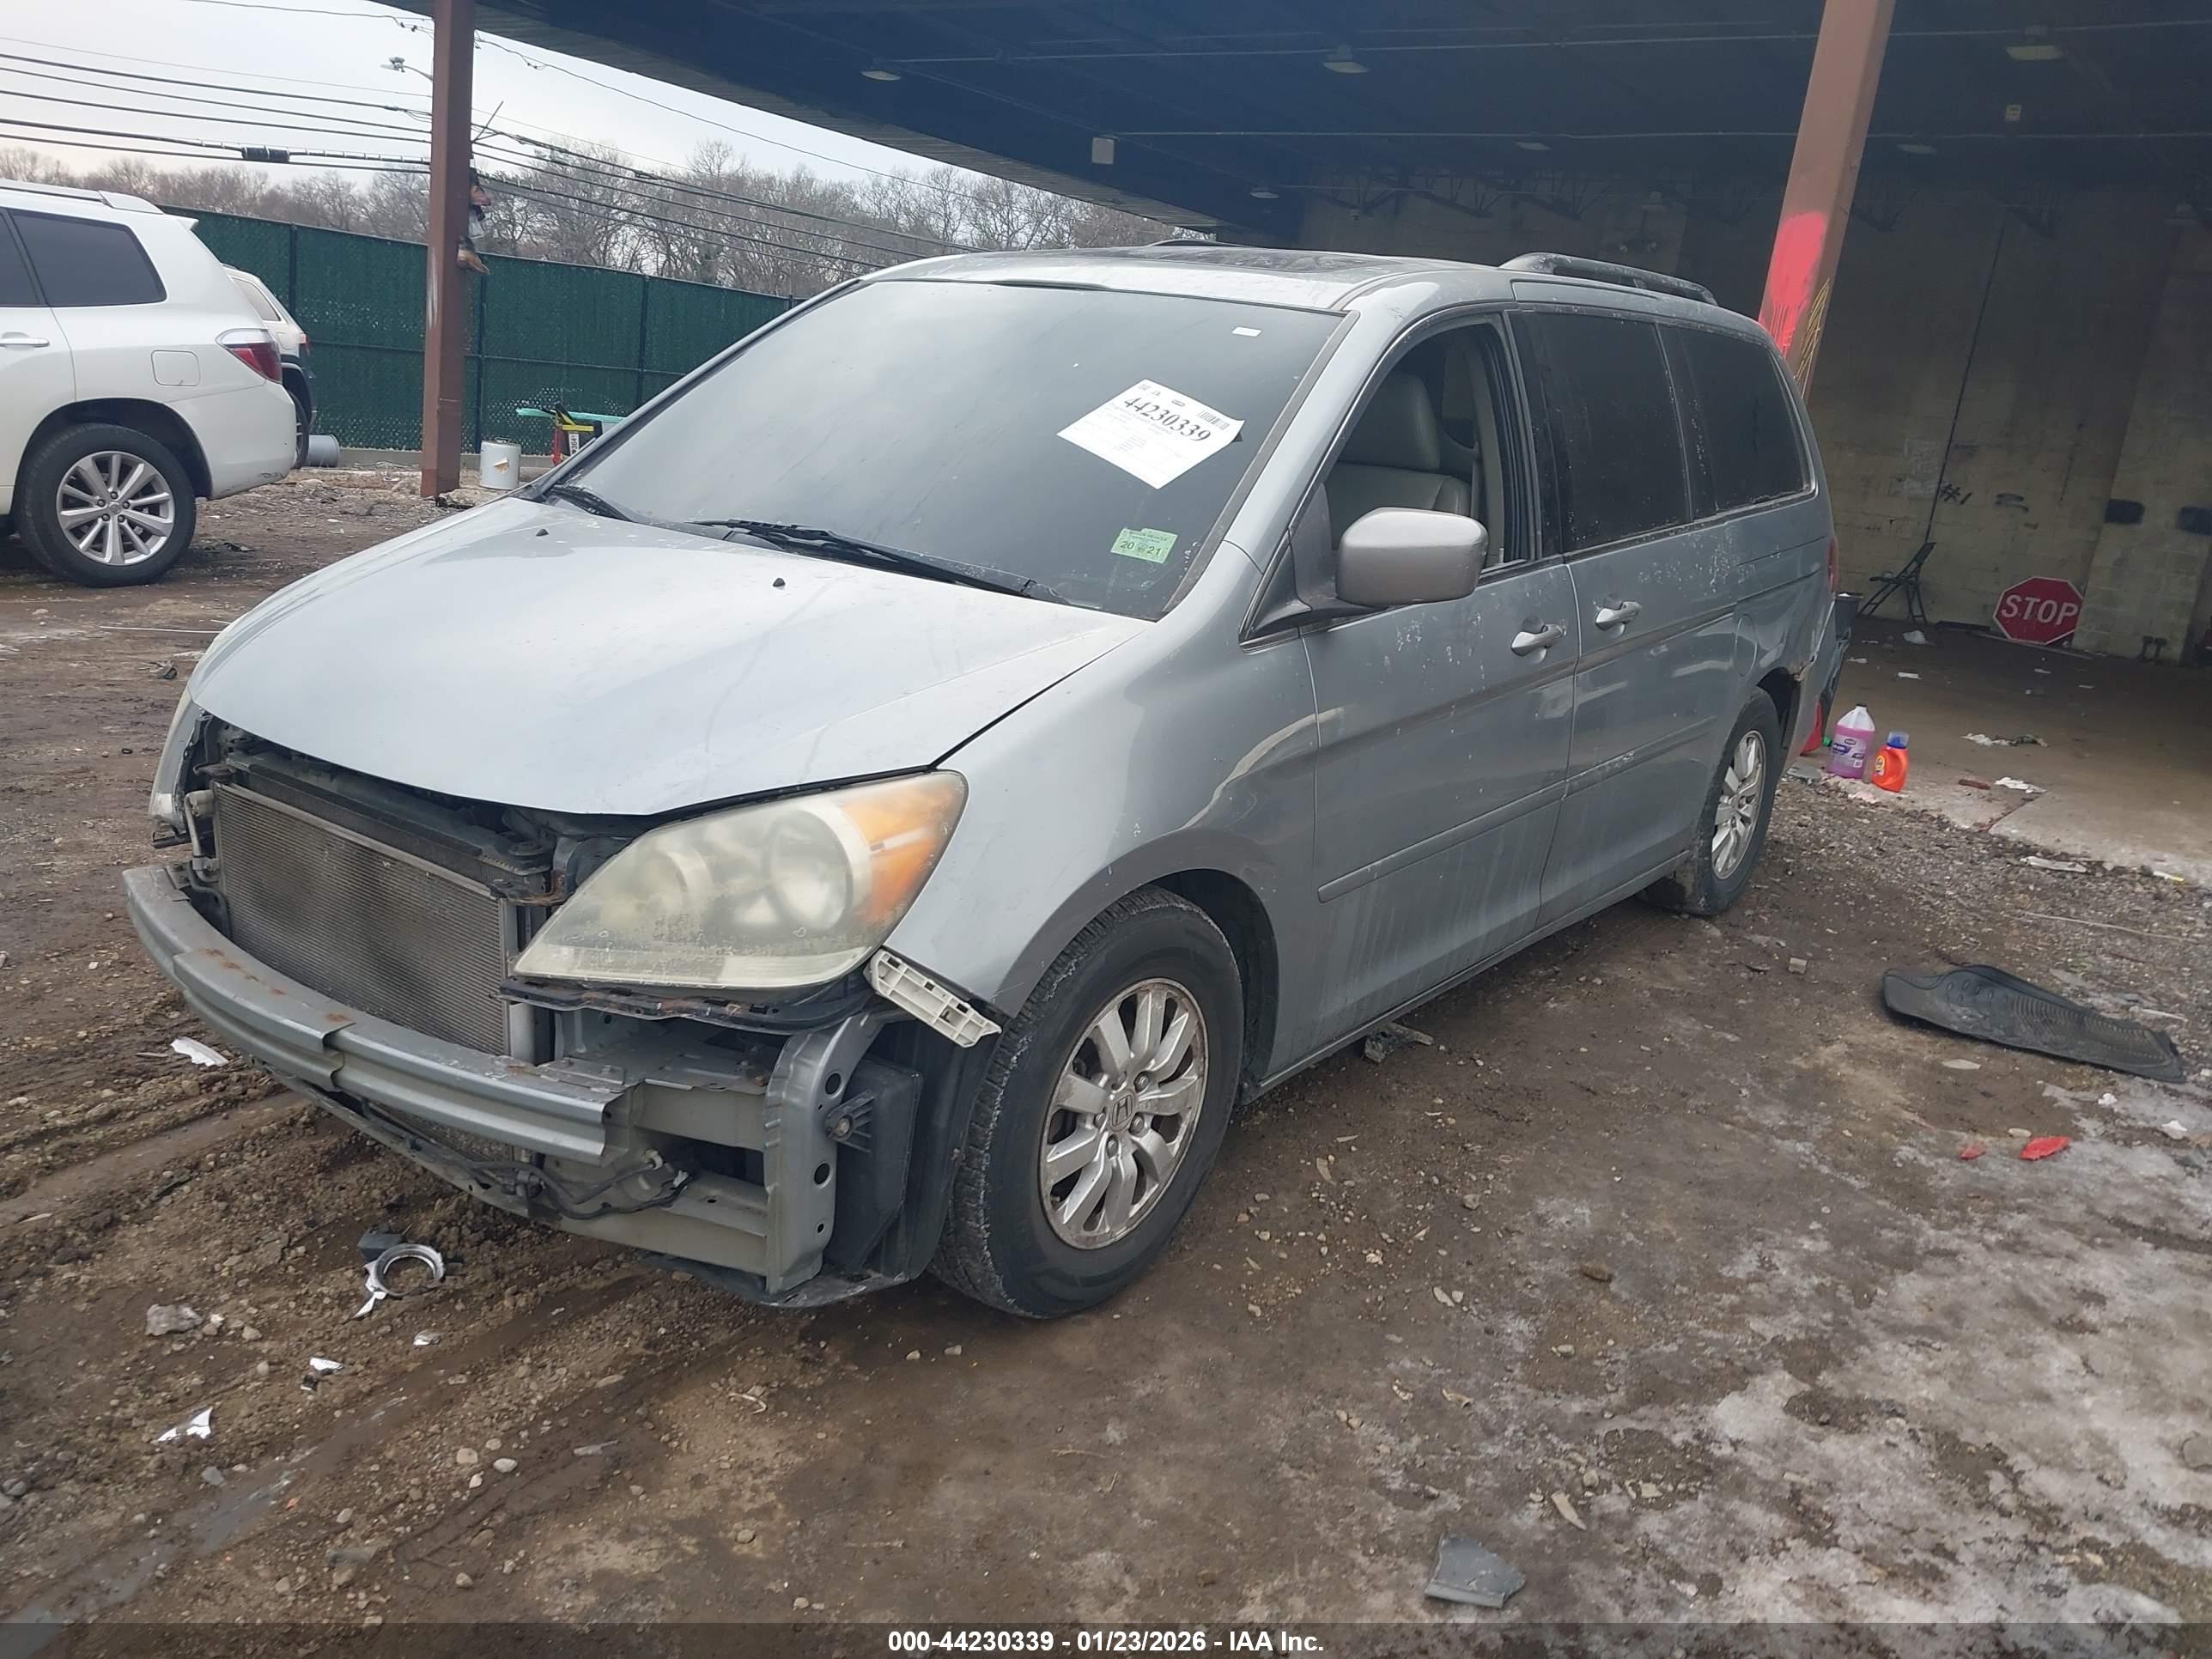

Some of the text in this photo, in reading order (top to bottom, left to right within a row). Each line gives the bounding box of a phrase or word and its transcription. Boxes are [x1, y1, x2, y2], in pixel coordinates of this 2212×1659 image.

[1124, 398, 1212, 441] 44230339
[1147, 546, 1162, 556] 21
[2001, 594, 2079, 625] STOP
